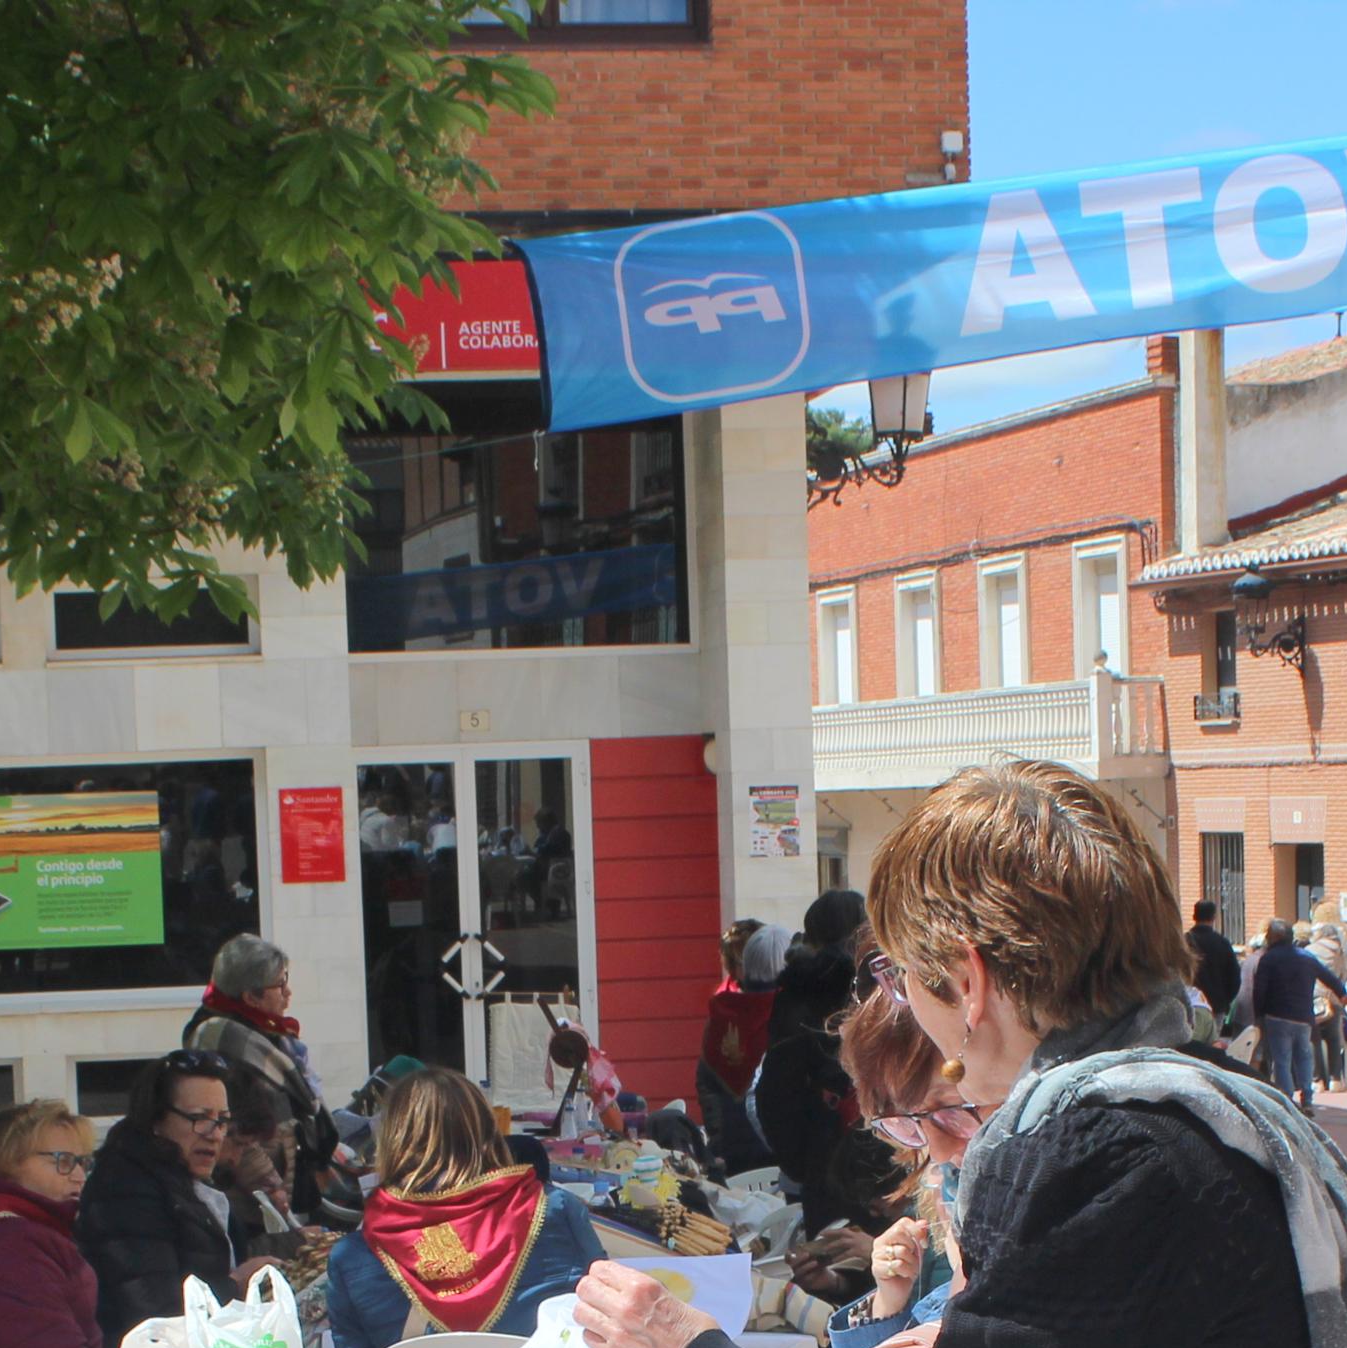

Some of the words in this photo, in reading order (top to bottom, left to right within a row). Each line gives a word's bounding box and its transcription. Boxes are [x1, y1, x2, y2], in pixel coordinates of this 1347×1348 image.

[458, 320, 521, 335] AGENTE
[470, 711, 480, 728] 5
[36, 859, 84, 874] Contigo
[86, 857, 124, 870] desde
[37, 874, 49, 887] el
[51, 873, 104, 888] principio
